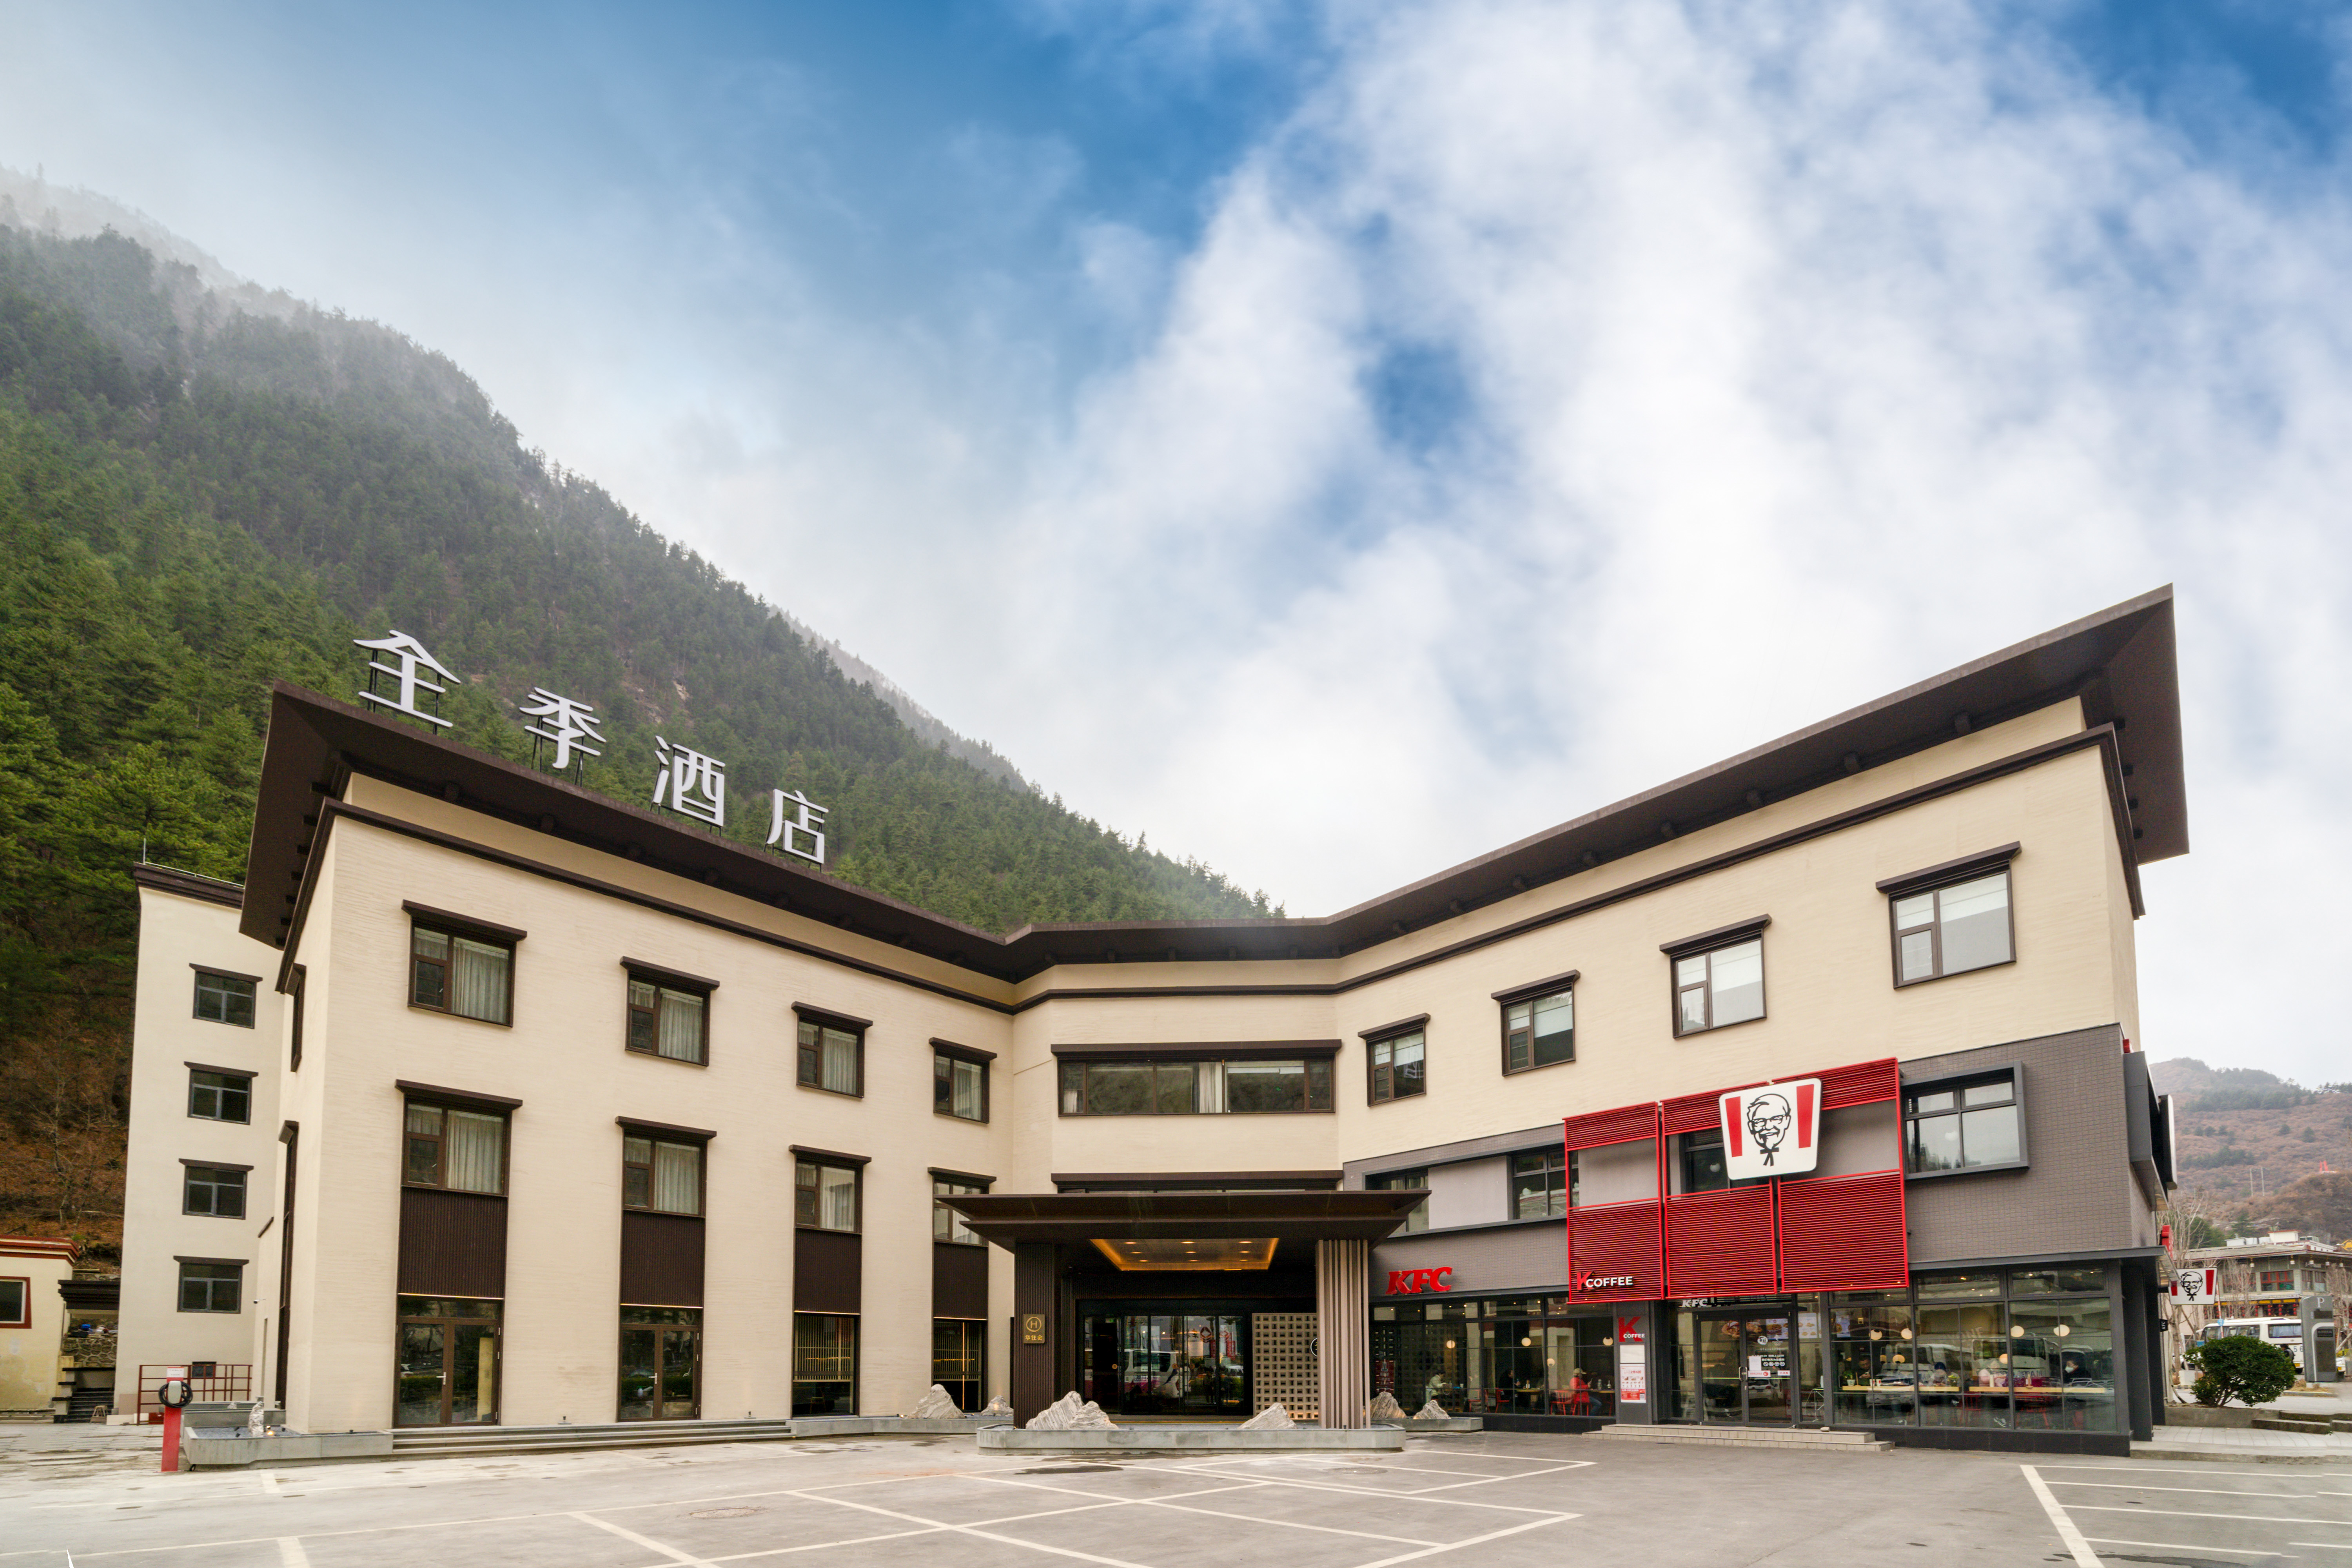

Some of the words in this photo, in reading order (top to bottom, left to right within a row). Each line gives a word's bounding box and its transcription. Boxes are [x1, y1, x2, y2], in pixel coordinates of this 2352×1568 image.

[353, 630, 829, 864] 全季酒店
[1386, 1267, 1452, 1294] KFC
[1681, 1299, 1708, 1307] KFC
[2317, 1297, 2325, 1308] P
